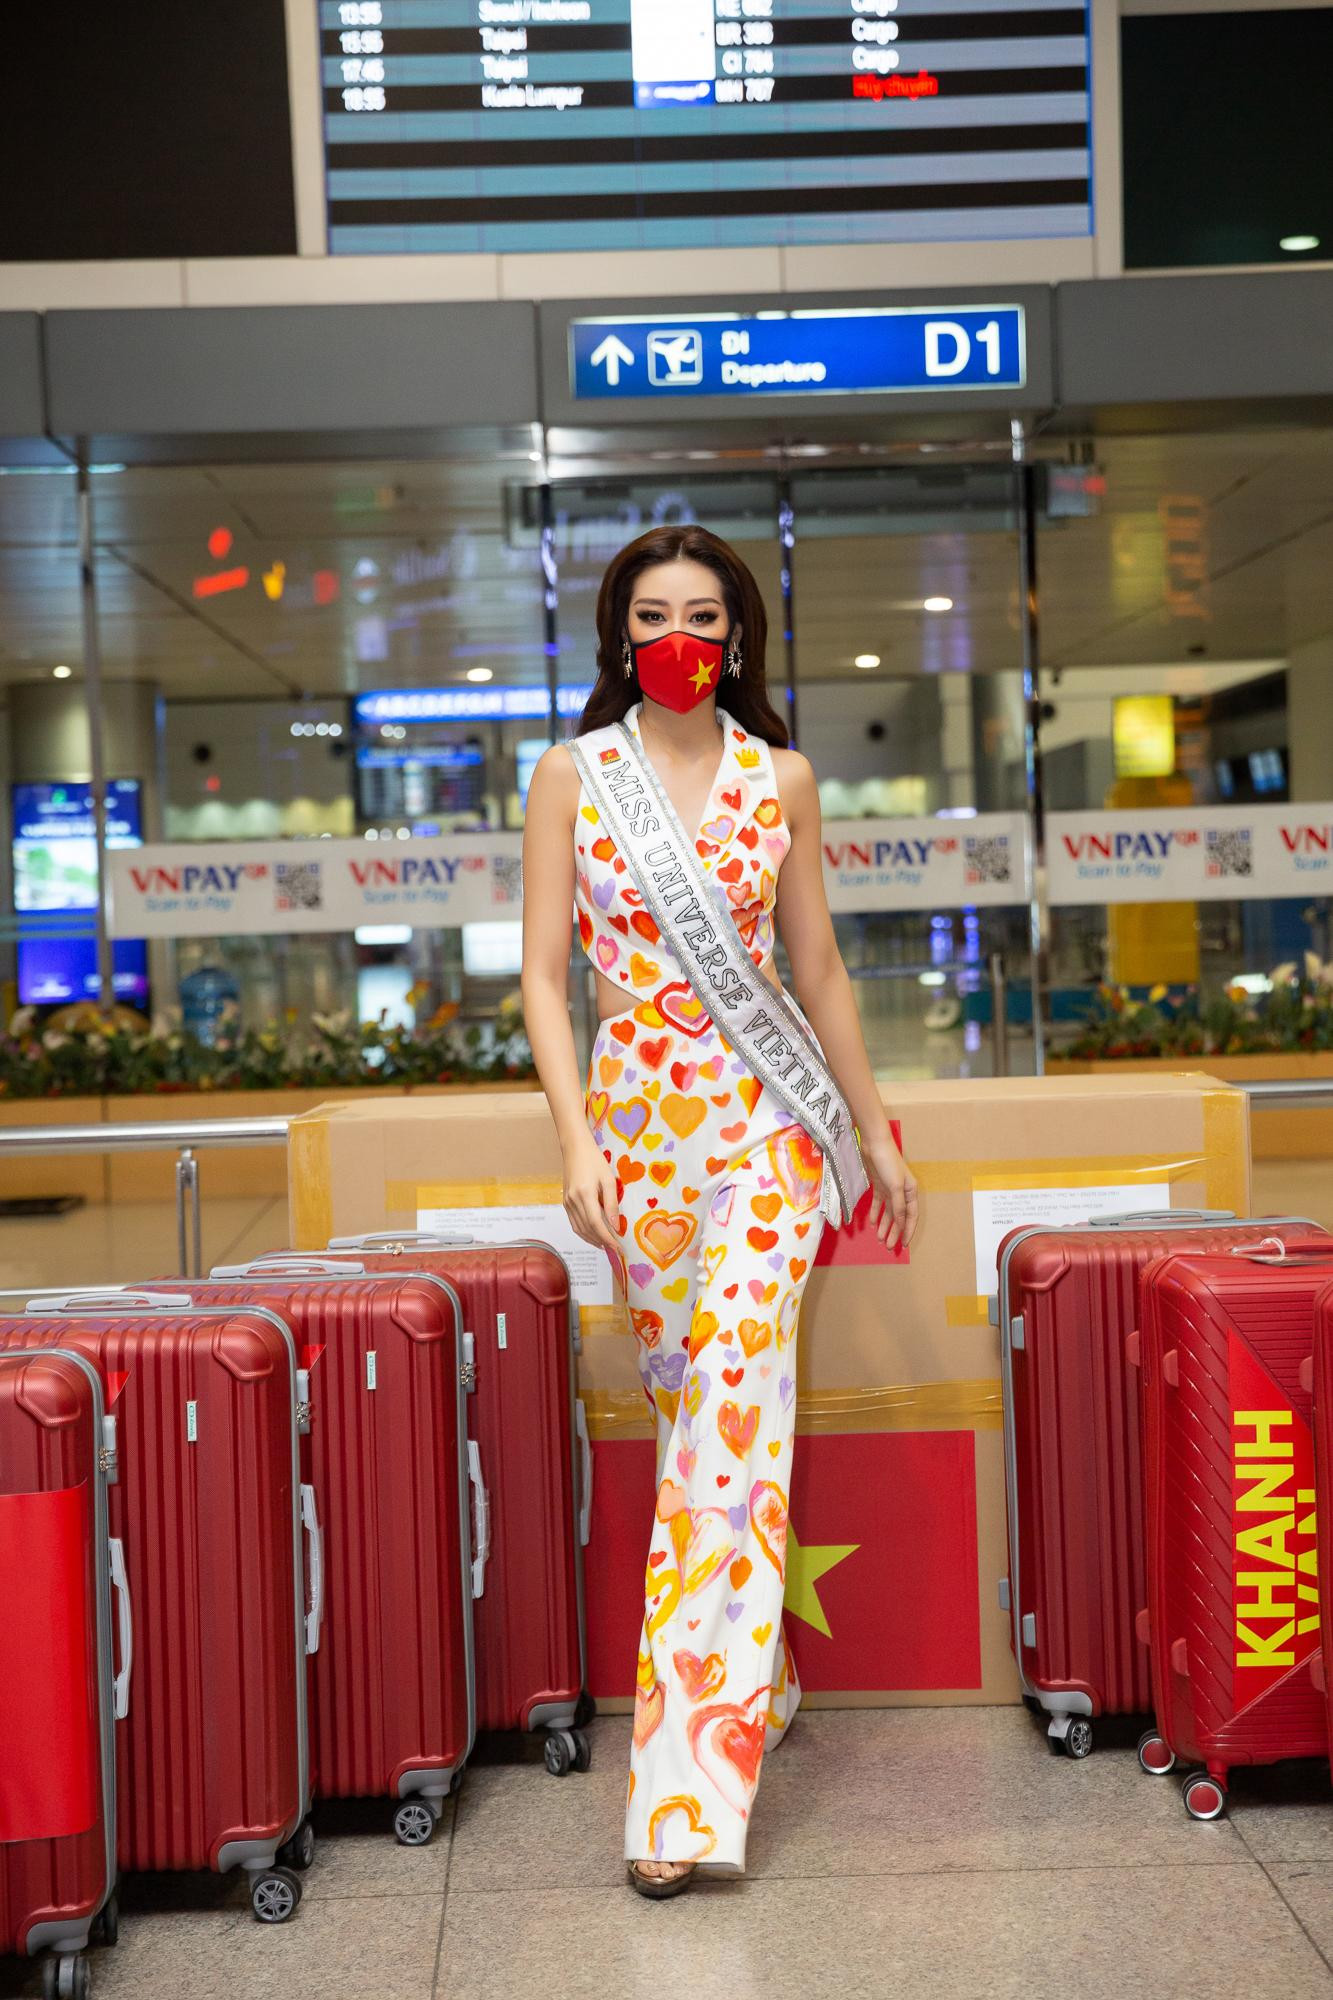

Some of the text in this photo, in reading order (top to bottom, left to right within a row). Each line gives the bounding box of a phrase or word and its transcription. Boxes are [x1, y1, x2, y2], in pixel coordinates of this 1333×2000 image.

[721, 360, 826, 388] Departure
[924, 320, 1000, 377] D1
[602, 760, 845, 1145] MISS UNIVERSE VIETNAM
[1234, 1410, 1295, 1667] KHANH
